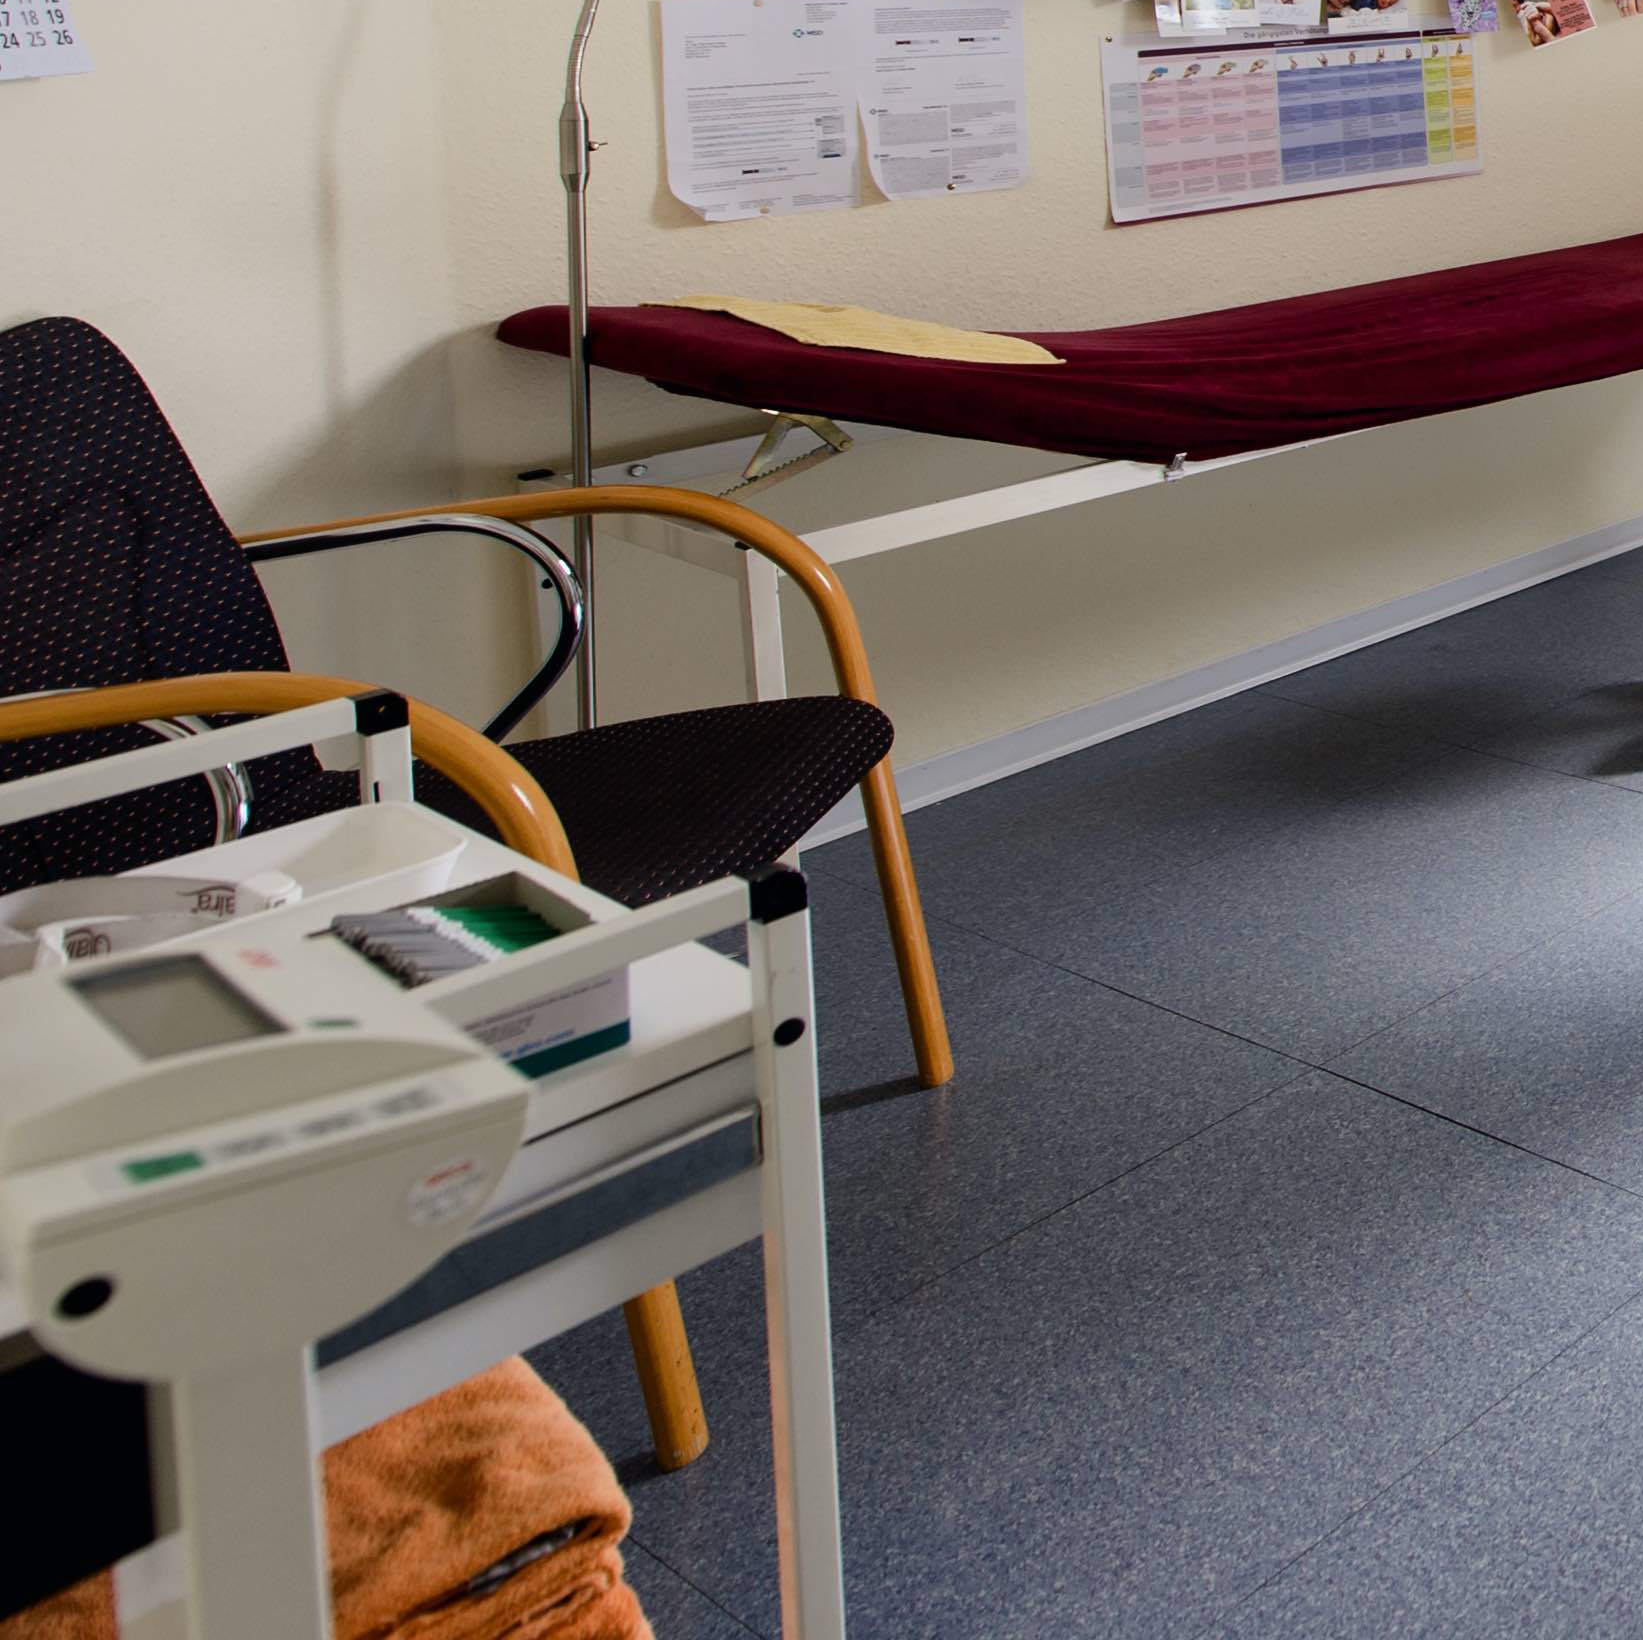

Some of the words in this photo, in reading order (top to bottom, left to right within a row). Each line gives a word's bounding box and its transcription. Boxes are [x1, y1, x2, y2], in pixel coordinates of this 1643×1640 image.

[0, 11, 10, 27] 7
[20, 10, 39, 26] 18
[47, 9, 65, 25] 19
[0, 32, 20, 49] 24
[26, 31, 46, 47] 25
[52, 30, 73, 46] 26
